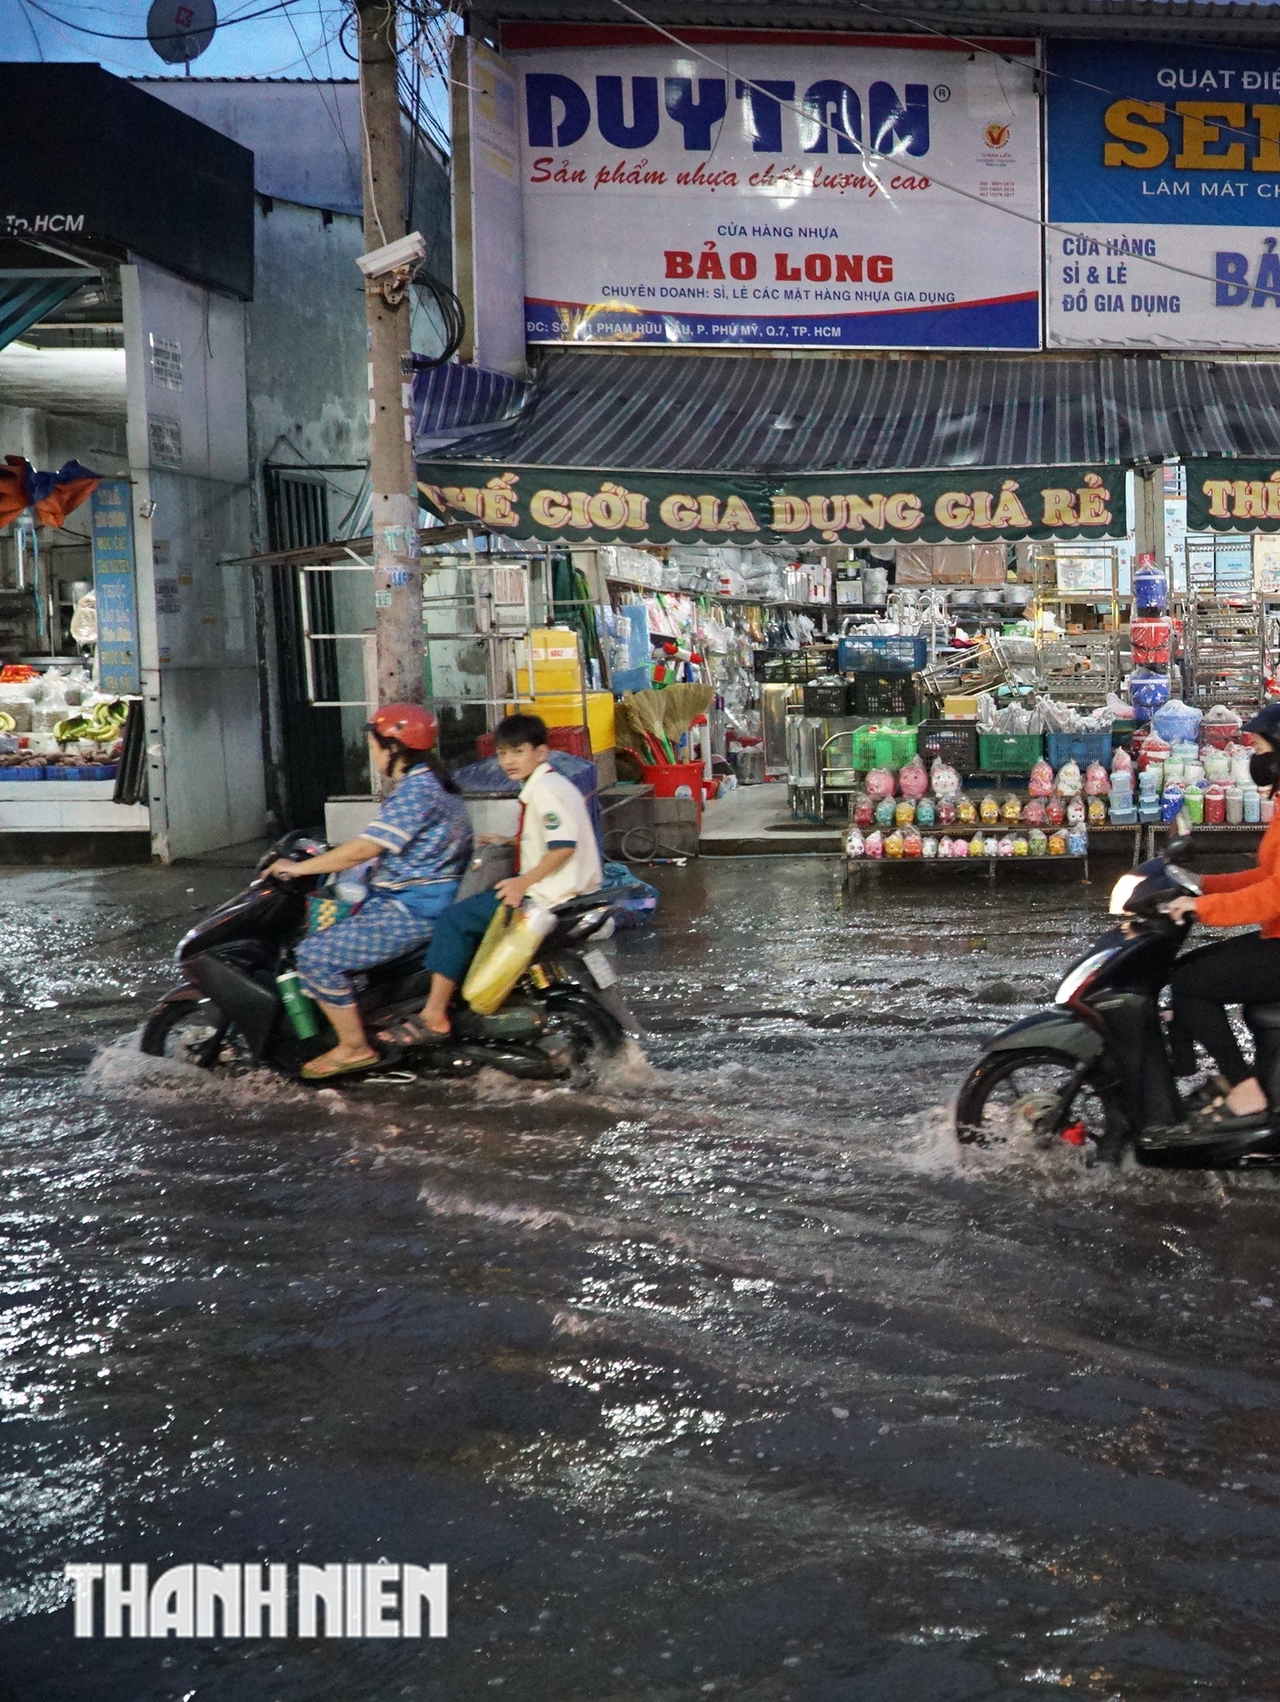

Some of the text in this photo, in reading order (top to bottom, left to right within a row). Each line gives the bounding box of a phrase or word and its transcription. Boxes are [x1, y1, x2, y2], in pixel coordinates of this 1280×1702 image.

[1156, 67, 1236, 92] QUẠT
[525, 72, 932, 158] DUYTAN
[530, 158, 587, 184] Sản
[594, 158, 669, 191] phẩm
[677, 161, 740, 192] nhựa
[890, 174, 932, 191] cao
[1142, 178, 1191, 197] LÀM
[1201, 181, 1249, 199] MÁT
[717, 223, 840, 242] CỬA HÀNG NHỰA
[1062, 233, 1156, 258] CỬA HÀNG
[663, 240, 894, 283] BẢO LONG
[1062, 261, 1127, 285] SỈ & LẺ
[601, 284, 656, 298] CHUYÊN
[660, 287, 710, 299] DOANH:
[733, 284, 748, 299] LẺ
[753, 286, 780, 300] CÁC
[784, 287, 811, 302] MẶT
[814, 286, 851, 301] HÀNG
[854, 289, 891, 305] NHỰA
[894, 290, 916, 304] GIA
[919, 291, 956, 306] DỤNG
[1062, 287, 1181, 318] ĐỒ GIA DỤNG
[527, 322, 549, 333] ĐC:
[636, 320, 662, 334] HỮU
[697, 323, 709, 335] P.
[740, 321, 763, 338] MỸ,
[766, 325, 789, 338] Q.7,
[792, 325, 811, 337] TP.
[814, 326, 842, 338] HCM
[529, 481, 650, 529] GIỚI
[658, 494, 762, 532] GIA
[769, 492, 925, 542] DỤNG
[934, 478, 1033, 529] GIÁ
[1041, 472, 1113, 528] RẺ
